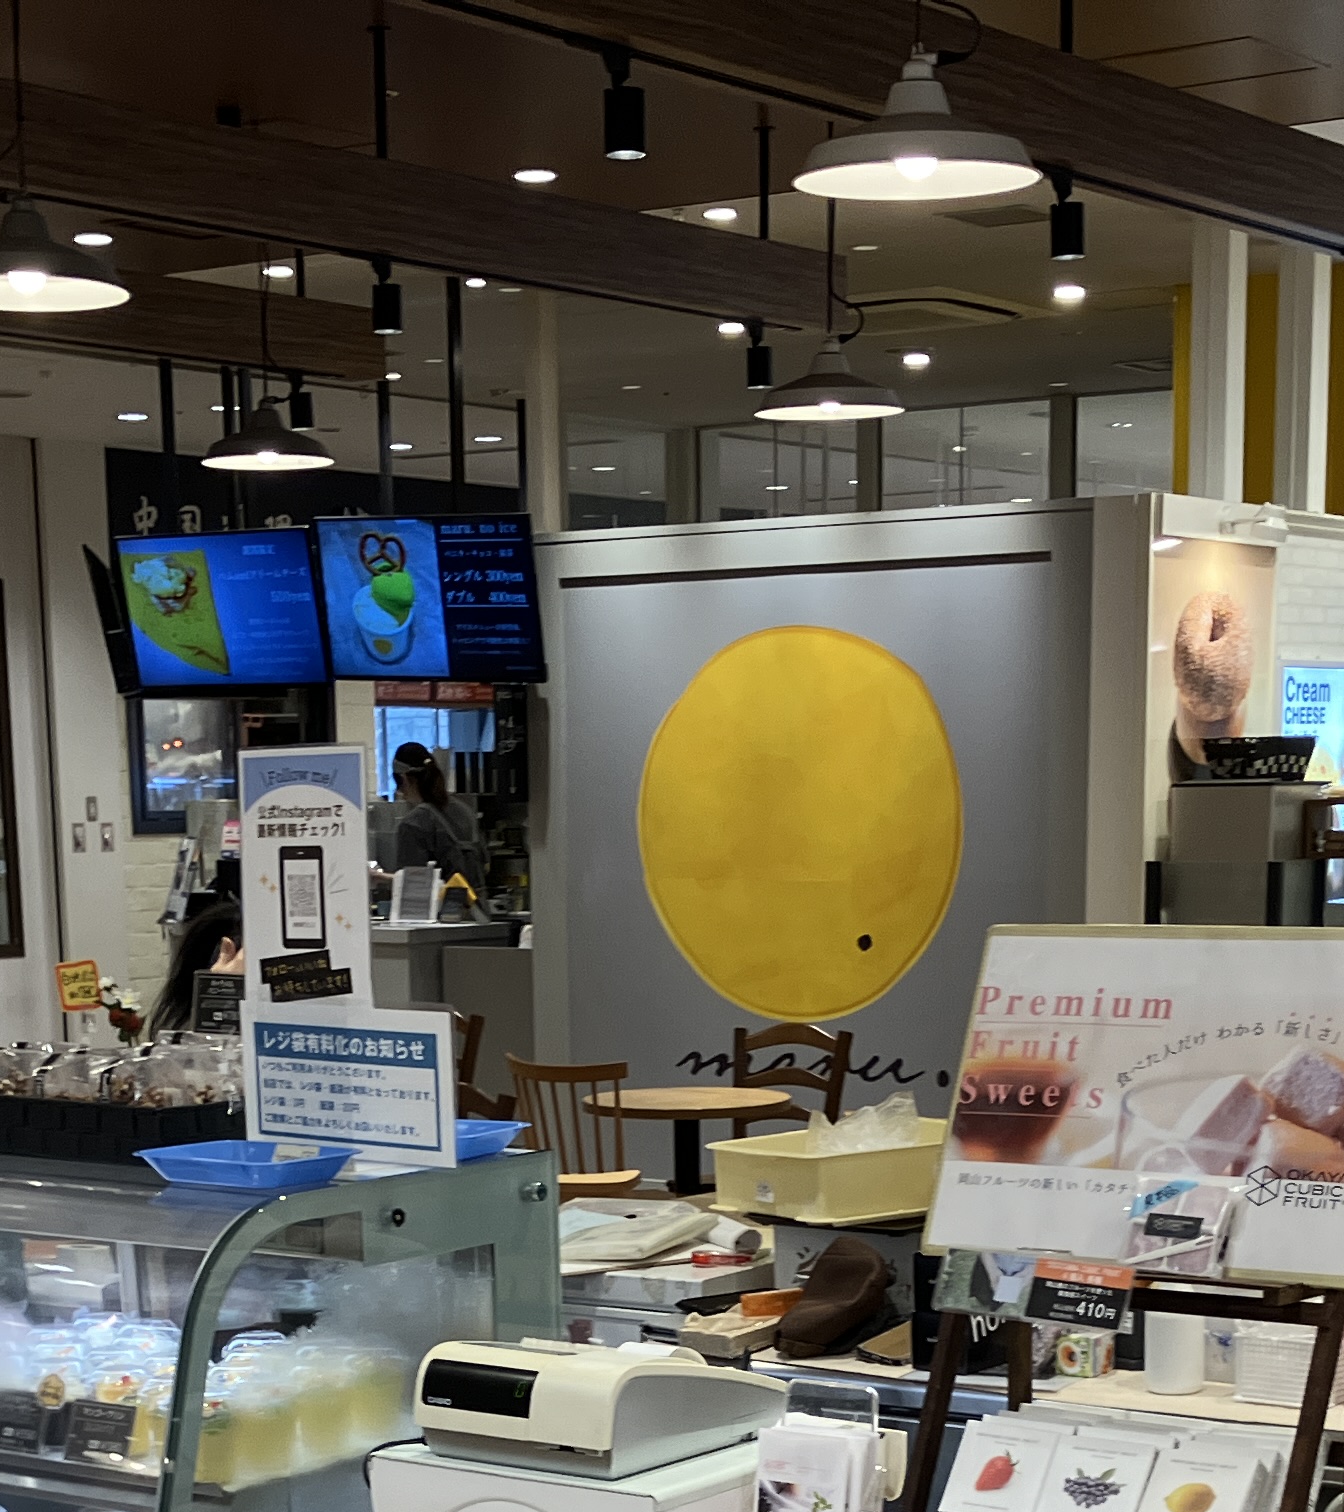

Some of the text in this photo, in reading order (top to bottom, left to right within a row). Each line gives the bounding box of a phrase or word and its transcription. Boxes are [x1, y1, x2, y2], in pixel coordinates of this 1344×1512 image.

[443, 569, 483, 582] シングル
[446, 589, 476, 604] ダブル
[1285, 675, 1332, 703] Cream
[1284, 706, 1327, 725] CHEESE
[976, 985, 1174, 1021] Premium
[263, 1030, 425, 1061] レジ袋有料化のお知らせ
[967, 1030, 1080, 1063] Fruit
[958, 1074, 1105, 1110] Sweets
[1284, 1182, 1344, 1198] CUBIC
[1282, 1196, 1342, 1210] FRUIT
[1075, 1301, 1117, 1320] 410円
